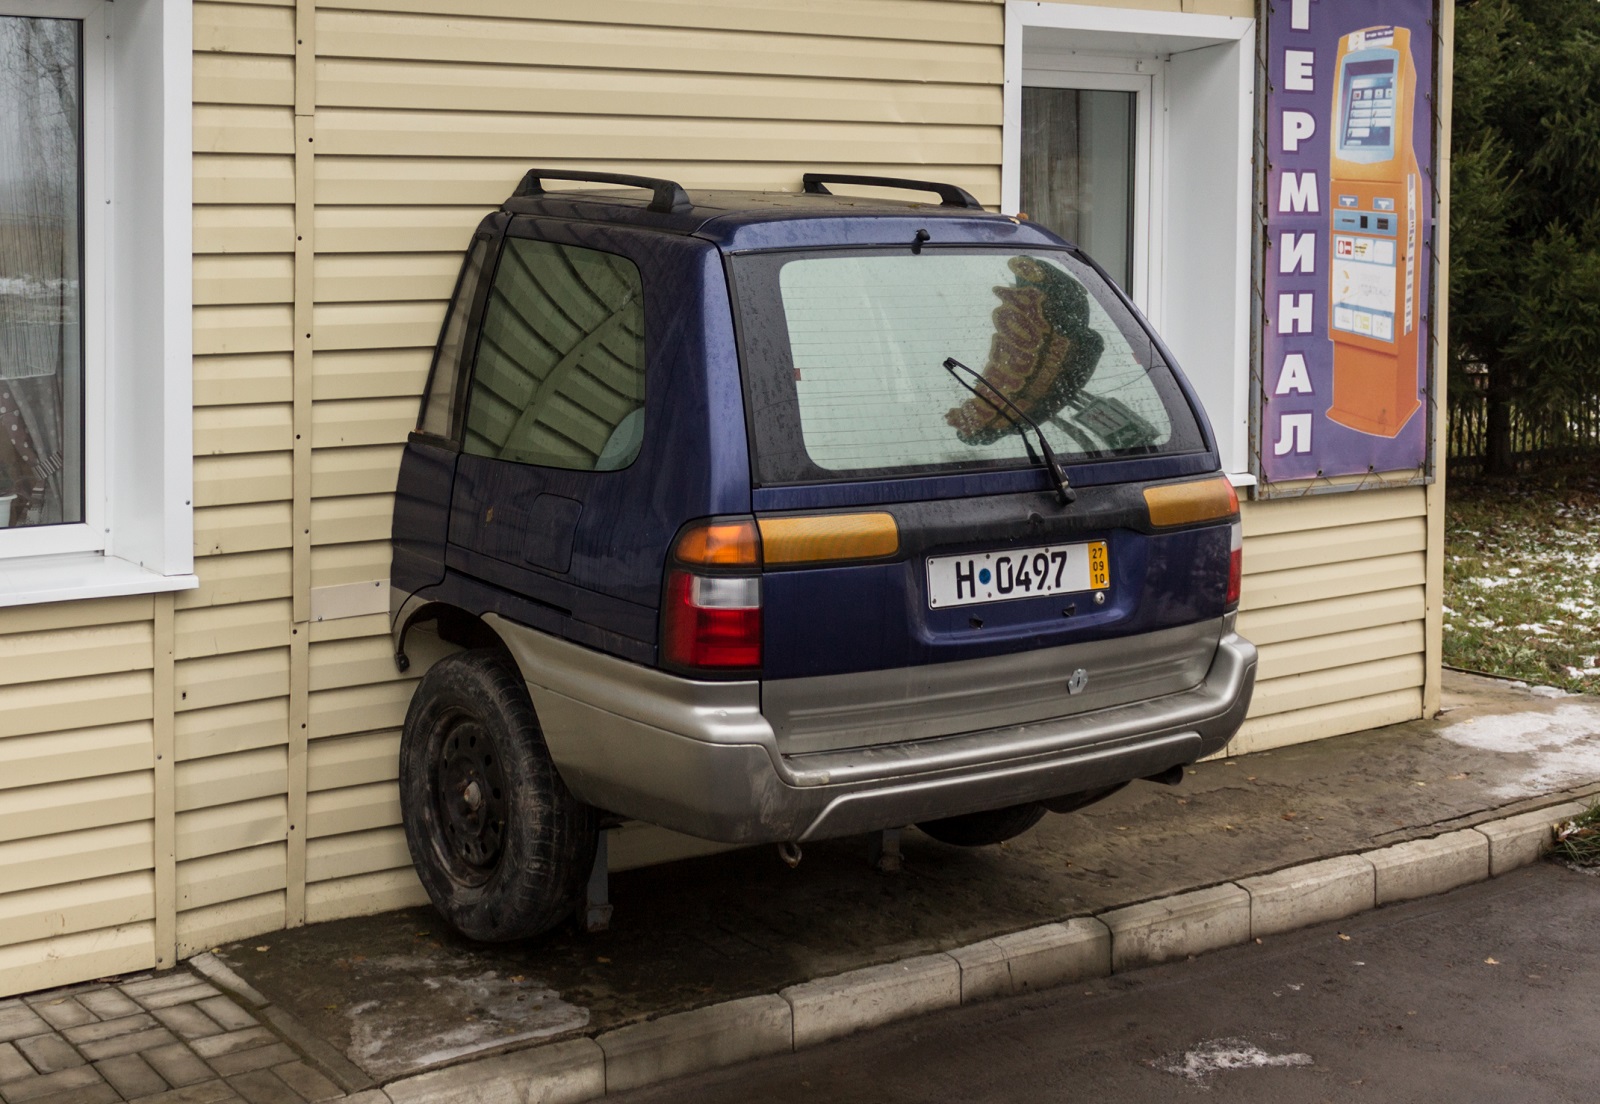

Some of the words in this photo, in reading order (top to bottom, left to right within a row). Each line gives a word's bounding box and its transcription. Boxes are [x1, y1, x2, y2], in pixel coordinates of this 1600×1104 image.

[1274, 0, 1320, 456] ТЕРМИНАЛ
[1092, 547, 1103, 559] 27
[1092, 560, 1105, 572] 09
[955, 559, 977, 600] H
[995, 550, 1068, 595] 0497
[1094, 573, 1106, 585] 10
